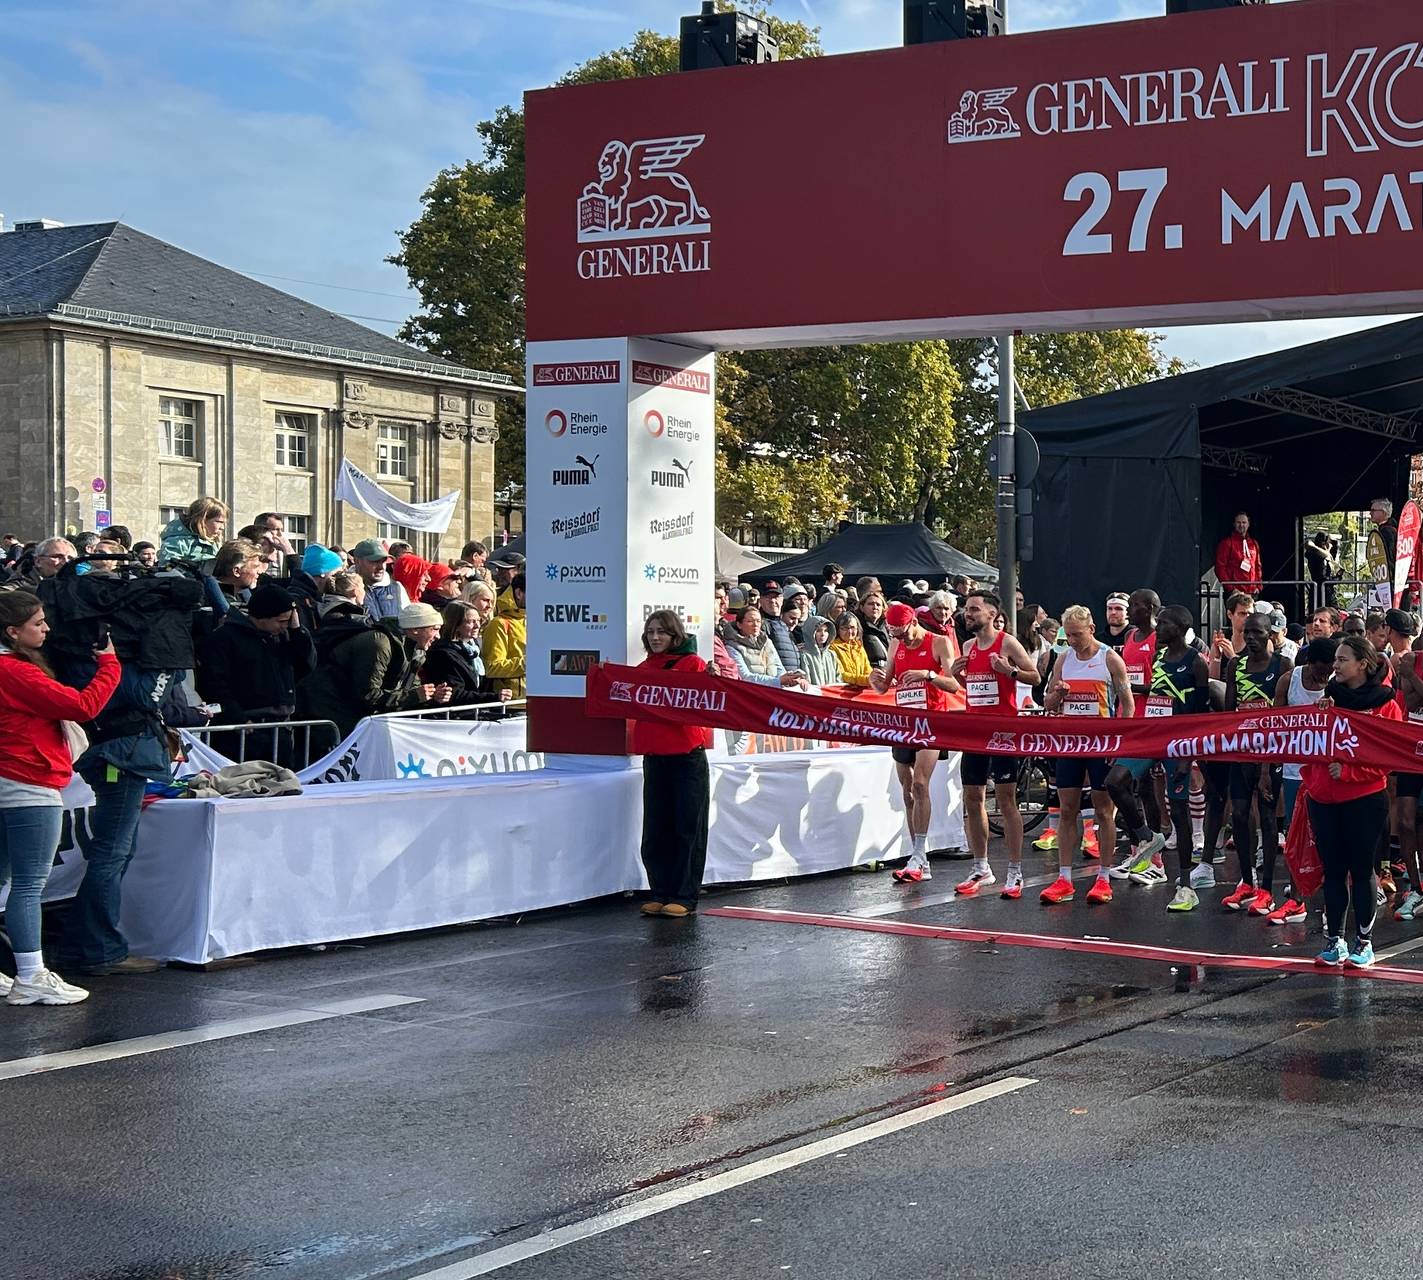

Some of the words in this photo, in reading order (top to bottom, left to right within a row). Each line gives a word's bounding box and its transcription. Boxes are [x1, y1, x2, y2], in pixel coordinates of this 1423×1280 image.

[1025, 57, 1290, 136] GENERALI
[1062, 167, 1183, 256] 27.
[576, 239, 712, 280] GENERALI
[555, 364, 617, 382] GENERALI
[653, 369, 708, 391] GENERALI
[570, 411, 598, 424] Rhein
[667, 415, 692, 429] Rhein
[570, 423, 608, 437] Energie
[667, 427, 700, 442] Energie
[552, 469, 590, 486] PUMA
[651, 470, 685, 488] PUMA
[551, 506, 601, 535] Reissdorf
[650, 511, 695, 535] Reissdorf
[560, 565, 606, 583] pixum
[658, 566, 699, 583] pixum
[544, 603, 591, 623] REWE
[971, 683, 990, 691] PACE
[635, 684, 728, 712] GENERALI
[1069, 703, 1091, 711] PACE
[850, 709, 911, 728] GENERALI
[1147, 707, 1164, 715] PACE
[1259, 713, 1328, 730] GENERALI
[1020, 733, 1123, 753] GENERALI
[1167, 733, 1216, 758] KÖLN
[1220, 729, 1327, 756] MARATHON
